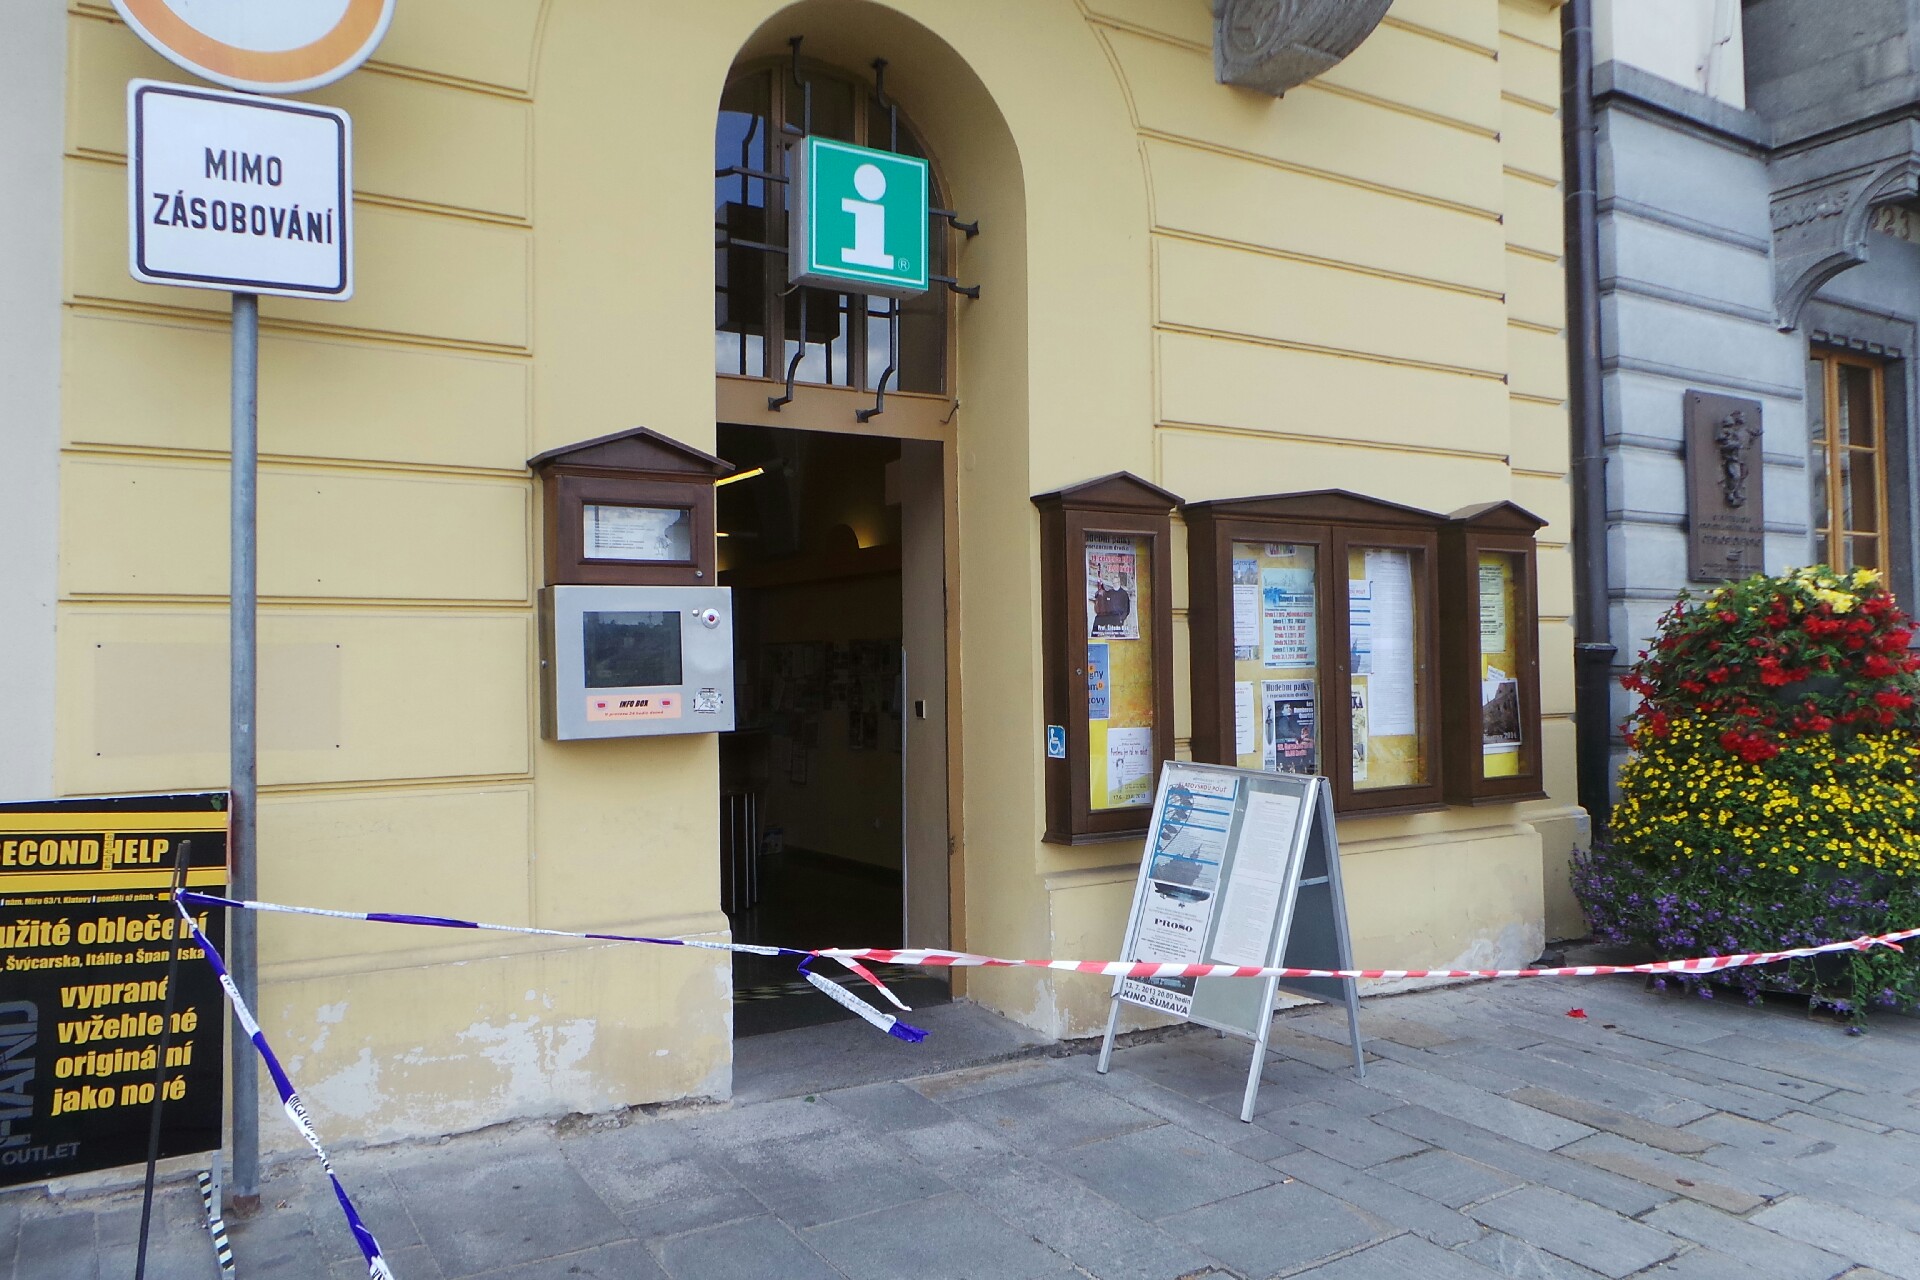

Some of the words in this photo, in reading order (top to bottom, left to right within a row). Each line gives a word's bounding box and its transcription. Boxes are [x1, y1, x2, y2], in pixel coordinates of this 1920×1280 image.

[205, 147, 282, 186] MIMO
[153, 189, 333, 244] ZÁSOBOVÁNÍ
[619, 700, 635, 708] INFO
[635, 699, 649, 707] BOX
[0, 838, 99, 866] ECOND
[104, 838, 170, 865] HELP
[63, 896, 91, 904] Klatovy
[0, 917, 71, 949] užité
[6, 954, 83, 971] Švýcarska,
[86, 951, 122, 966] Itálie
[125, 953, 134, 964] a
[136, 948, 206, 965] Španlska
[1122, 989, 1147, 1003] KINO
[1148, 995, 1188, 1015] ŠUMAVA
[1141, 986, 1156, 995] 2013
[1157, 990, 1174, 1000] 20.00
[1174, 994, 1191, 1005] hodin
[58, 1006, 198, 1044] vyžehlené
[51, 1084, 115, 1117] jako
[2, 1142, 81, 1166] OUTLET
